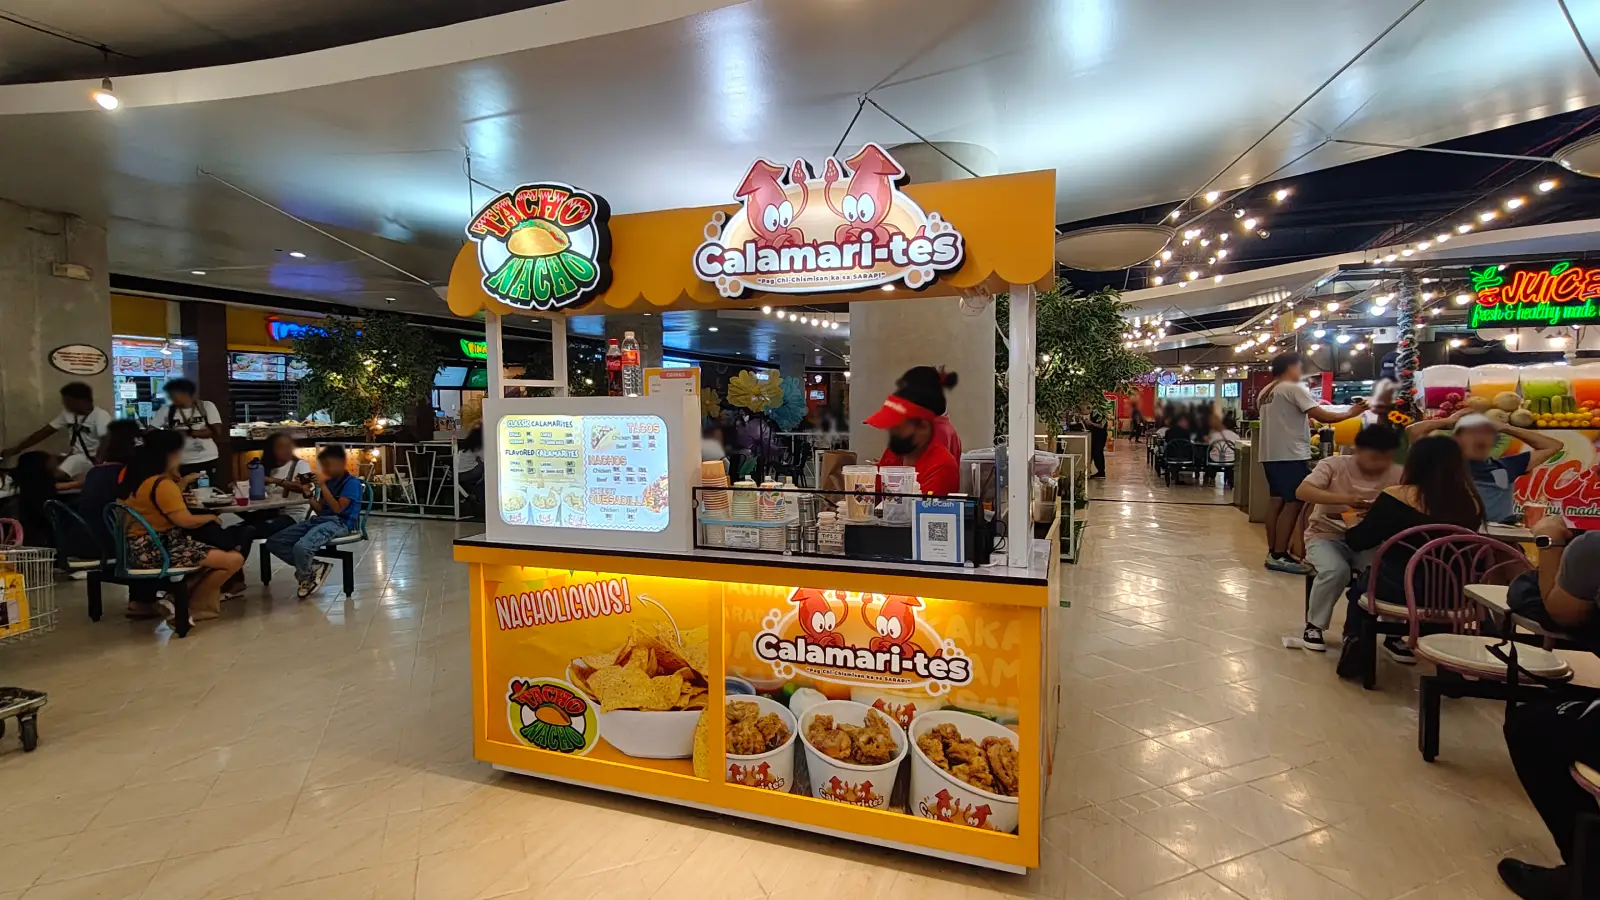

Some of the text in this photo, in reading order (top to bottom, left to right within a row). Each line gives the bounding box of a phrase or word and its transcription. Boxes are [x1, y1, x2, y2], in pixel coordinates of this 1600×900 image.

[471, 188, 592, 238] TACHO
[698, 231, 958, 276] Calamari-tes
[487, 252, 595, 301] NACHO
[1472, 298, 1597, 327] fresh & healthy made
[627, 422, 660, 434] TACOS
[588, 455, 628, 466] NACHOS
[495, 577, 632, 630] NACHOLICIOUS!
[756, 635, 969, 682] Calamari-tes
[515, 684, 587, 714] TACHO
[523, 720, 585, 751] NACHO
